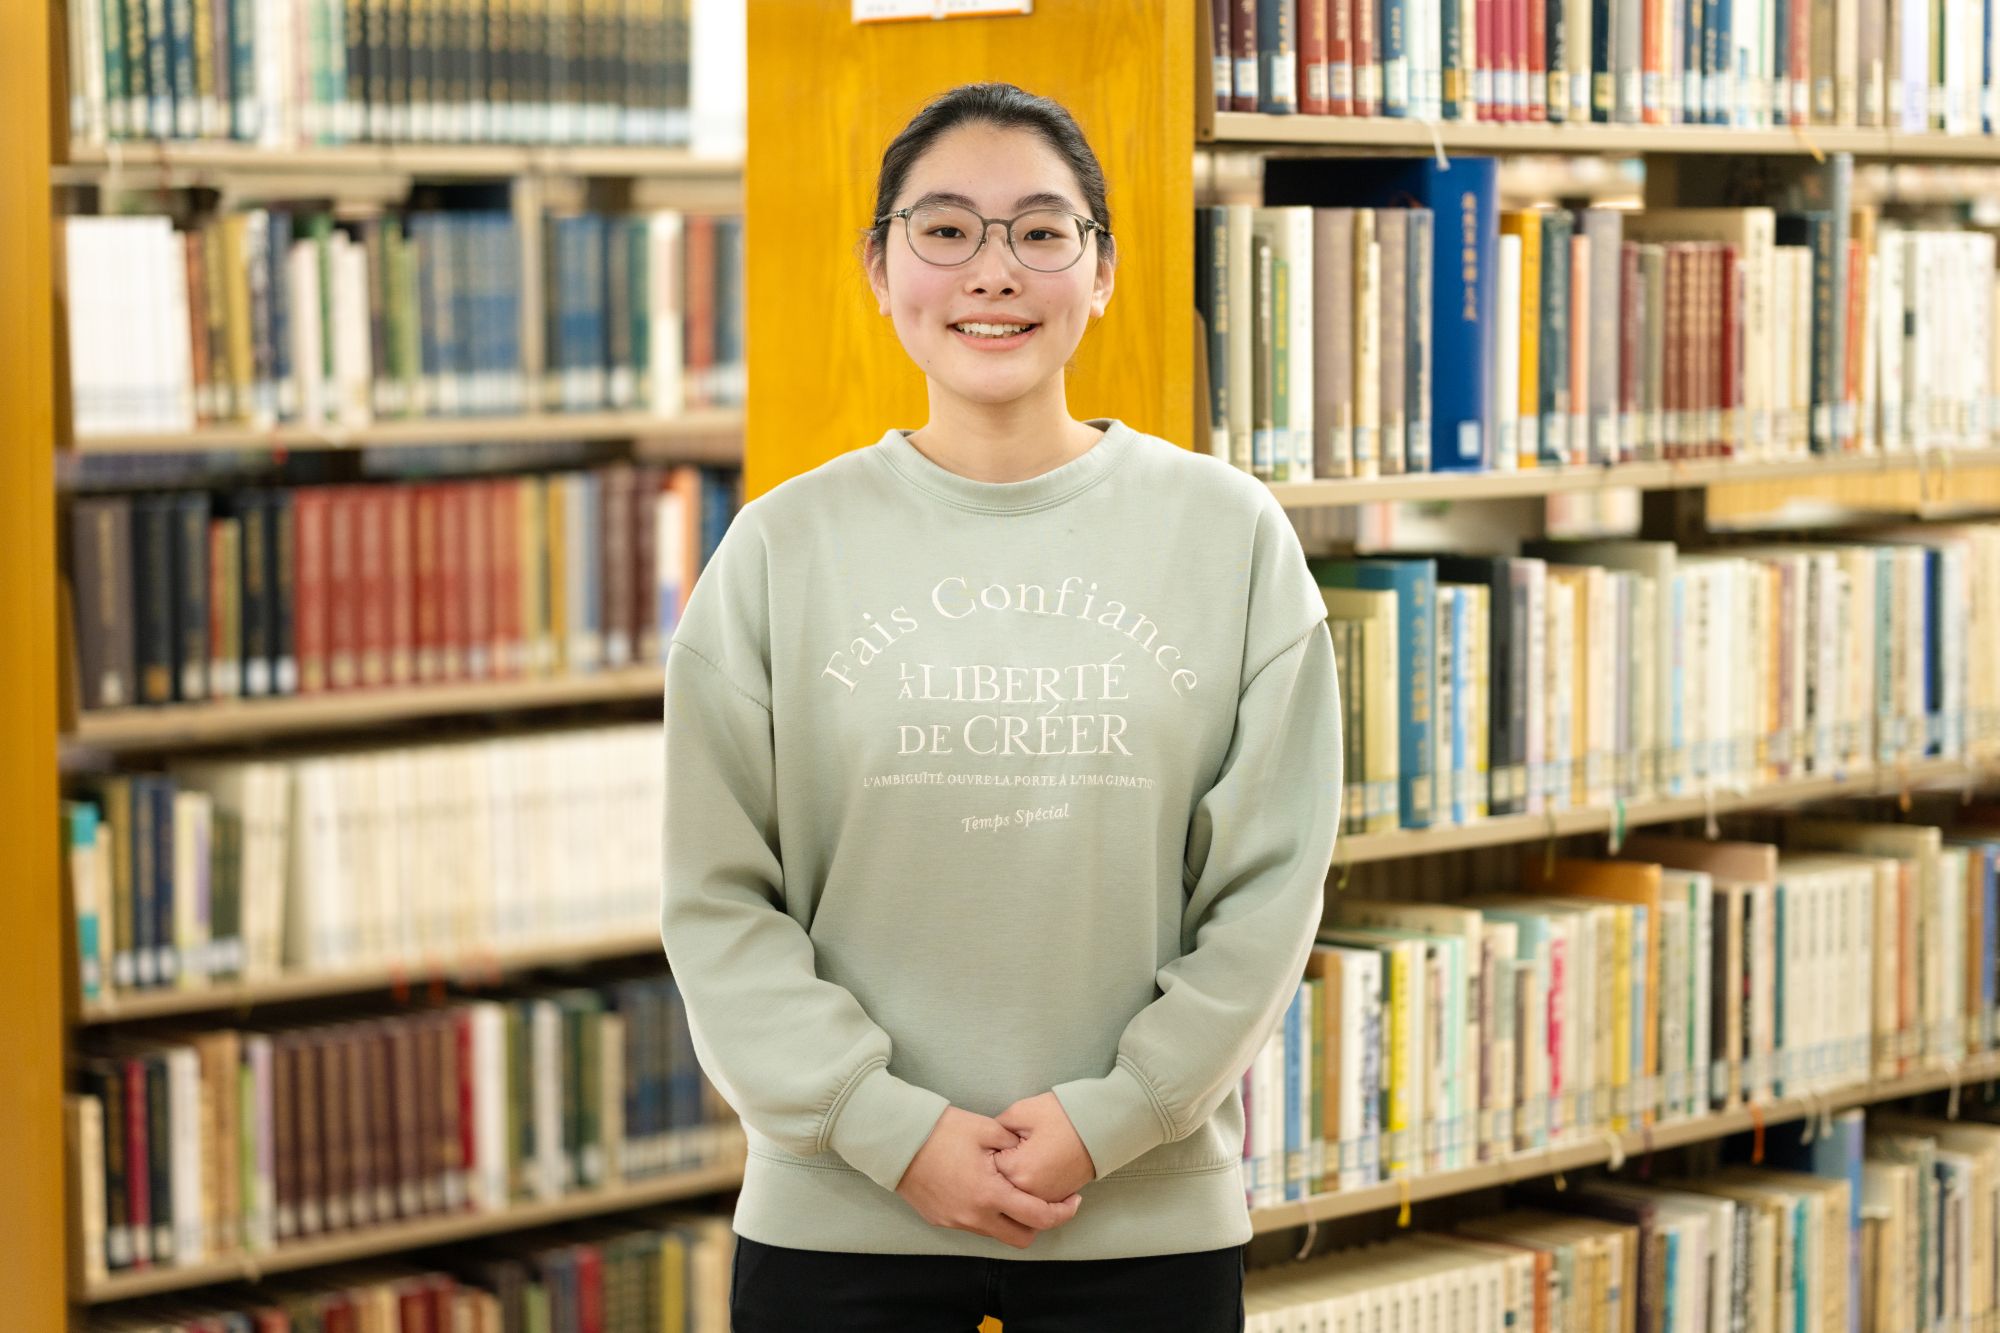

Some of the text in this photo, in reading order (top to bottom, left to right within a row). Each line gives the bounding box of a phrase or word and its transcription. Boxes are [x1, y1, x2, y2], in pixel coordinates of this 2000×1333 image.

[821, 576, 1198, 698] Fais Confiance
[919, 653, 1129, 703] LIBERTÉ
[897, 703, 1134, 756] DE CRÉER
[947, 774, 992, 785] OUVRE
[994, 775, 1010, 786] LA
[1014, 775, 1057, 786] PORTE
[1070, 774, 1155, 790] L'IMAGINATIO
[961, 803, 1070, 832] Temps Spécial
